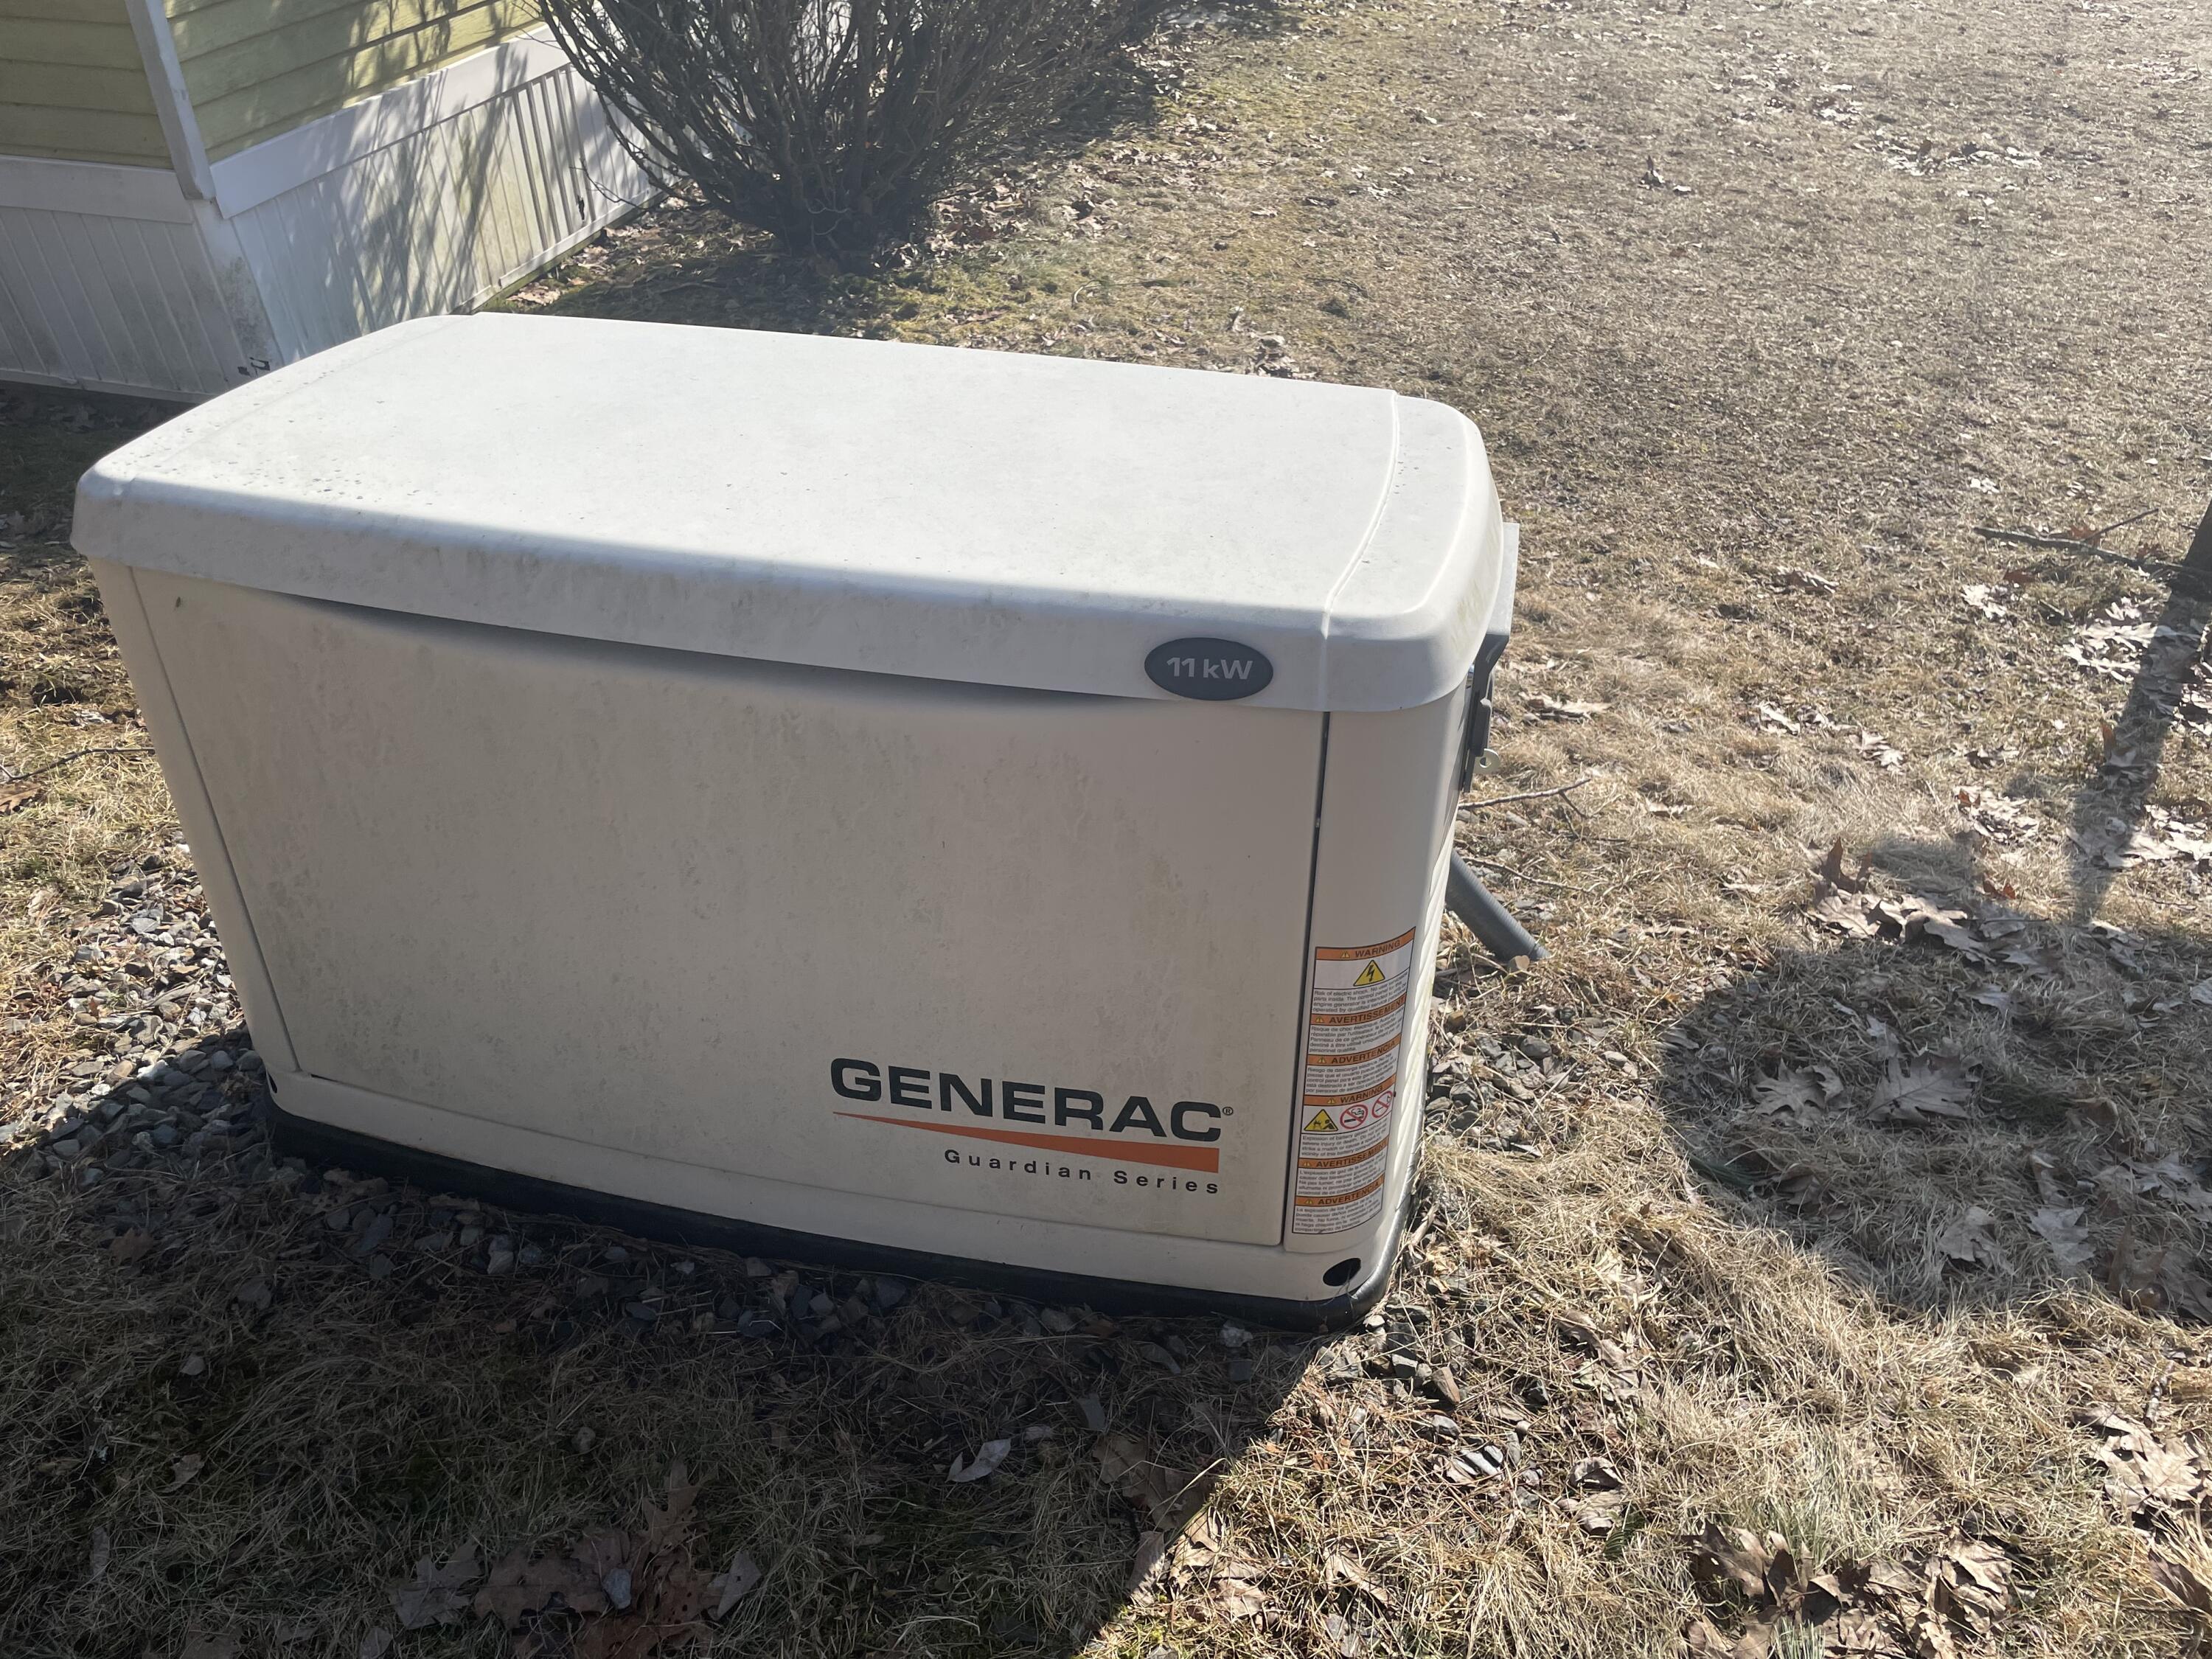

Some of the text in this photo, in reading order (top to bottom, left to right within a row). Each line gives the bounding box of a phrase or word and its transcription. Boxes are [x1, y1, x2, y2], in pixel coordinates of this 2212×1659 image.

[1166, 657, 1253, 680] 11 kW
[1354, 940, 1401, 957] WARNING
[1329, 997, 1405, 1023] AVERTISSEMENT
[1331, 1041, 1395, 1064] ADVERTENCIA
[1340, 1085, 1383, 1104] WARNING
[1316, 1141, 1386, 1167] AVERTISSEMENT
[944, 1149, 1220, 1194] Guardian Series
[1318, 1182, 1380, 1205] ADVERTENCIA
